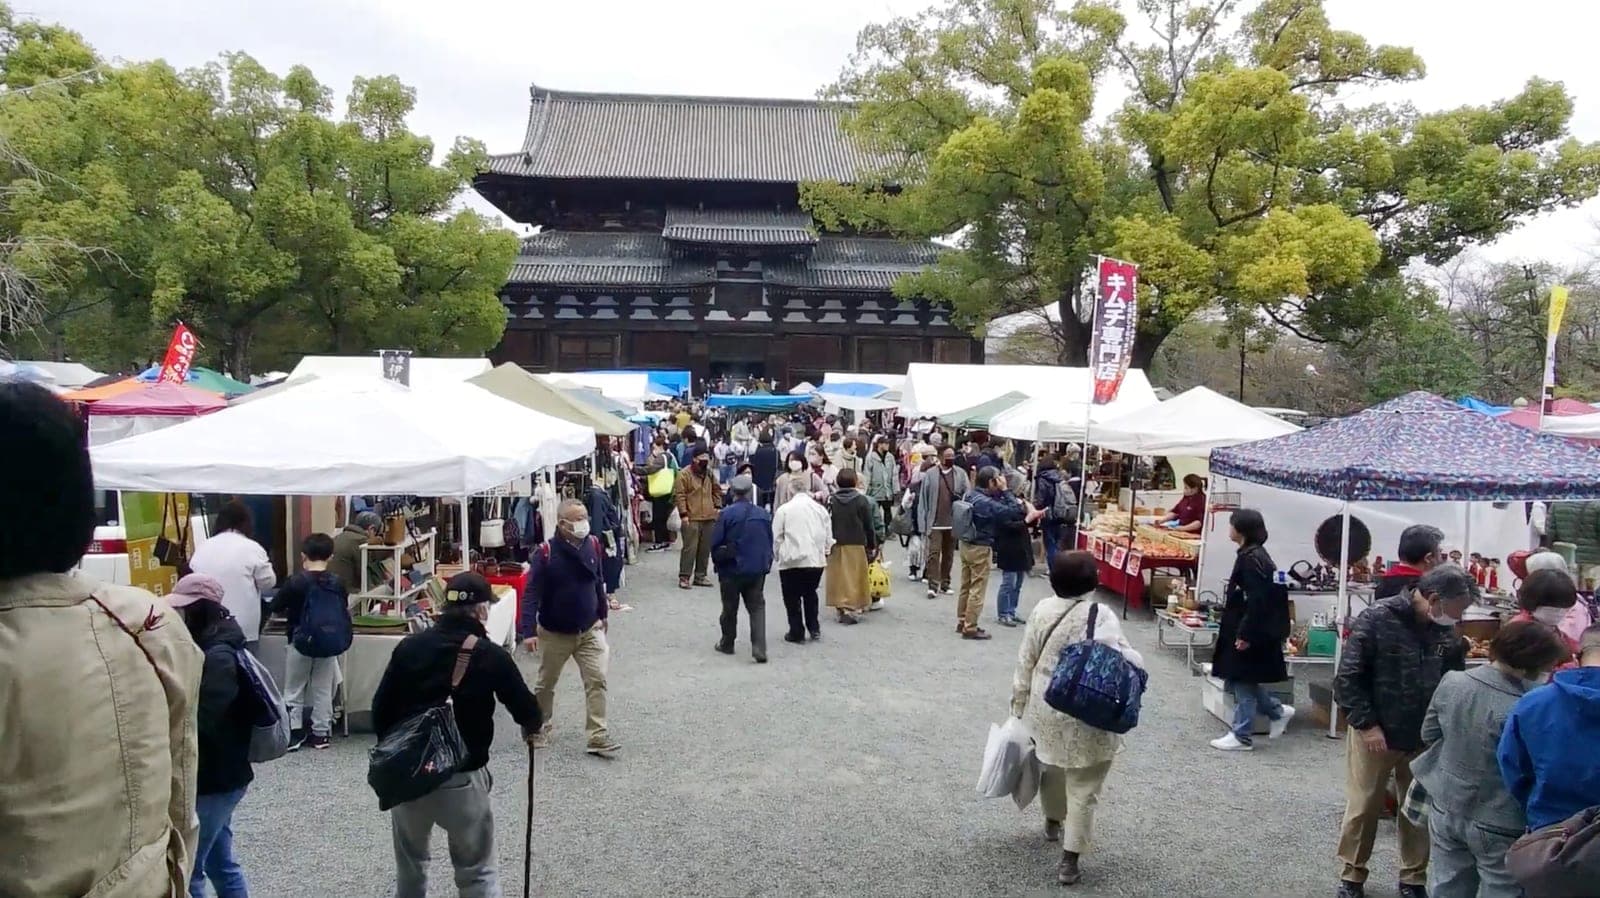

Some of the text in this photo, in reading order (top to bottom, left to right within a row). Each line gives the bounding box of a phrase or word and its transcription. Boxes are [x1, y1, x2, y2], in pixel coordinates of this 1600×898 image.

[1098, 273, 1126, 381] キムチ専門店
